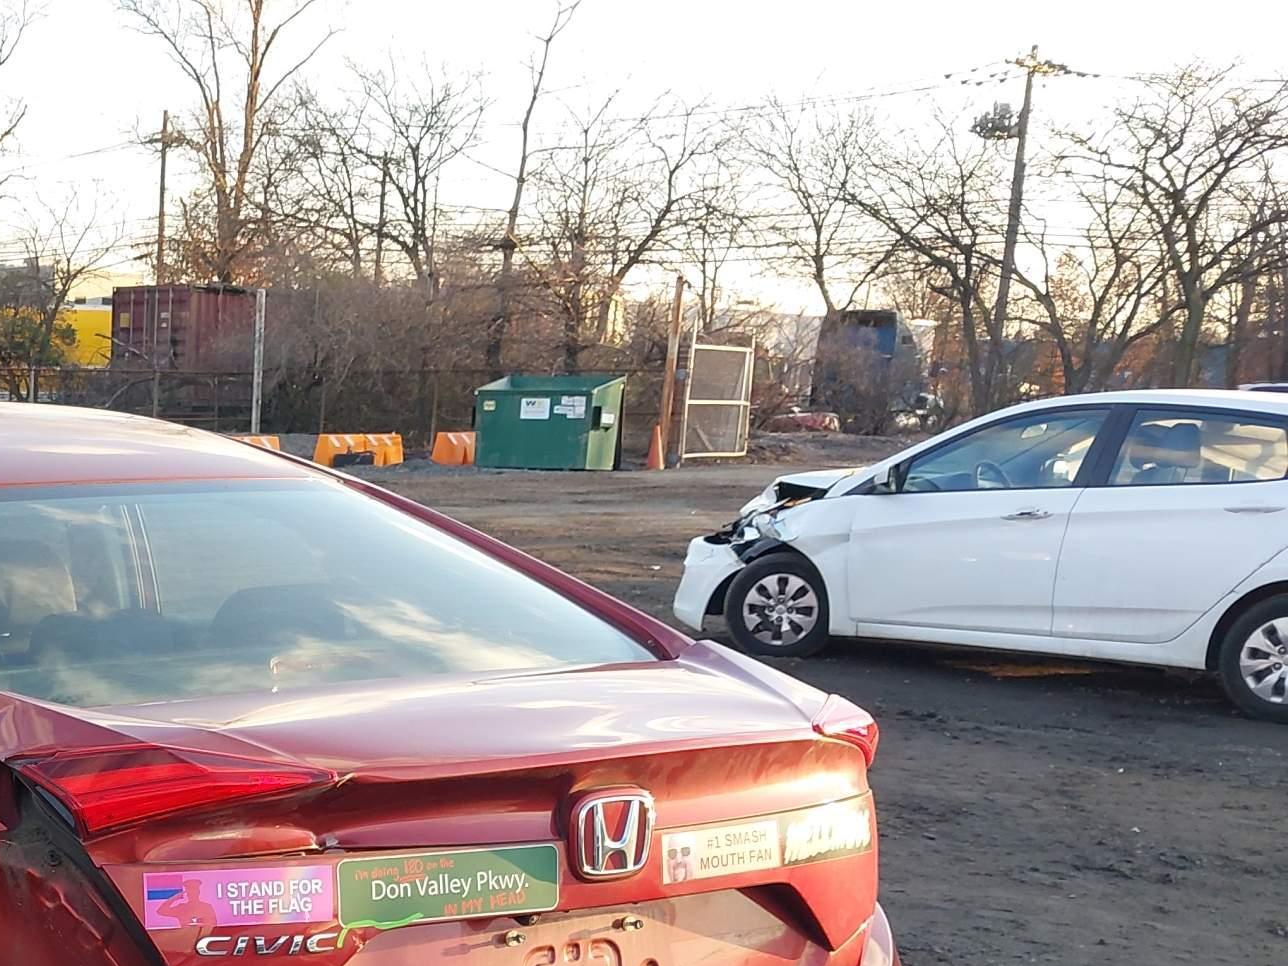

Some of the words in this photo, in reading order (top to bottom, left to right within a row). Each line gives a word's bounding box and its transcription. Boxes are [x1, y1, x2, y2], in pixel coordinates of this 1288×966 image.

[707, 836, 721, 849] #1
[724, 830, 766, 847] SMASH
[700, 853, 745, 871] MOUTH
[749, 848, 772, 863] FAN
[217, 883, 223, 898] I
[227, 881, 285, 898] STAND
[289, 879, 323, 896] FOR
[371, 880, 411, 901] Don
[416, 874, 471, 898] Valley
[477, 870, 529, 894] Pkwy.
[230, 899, 264, 916] THE
[268, 897, 312, 914] FLAG
[444, 903, 457, 916] IN
[462, 898, 483, 914] MY
[490, 891, 526, 909] HEAD
[195, 933, 339, 956] CIVIC
